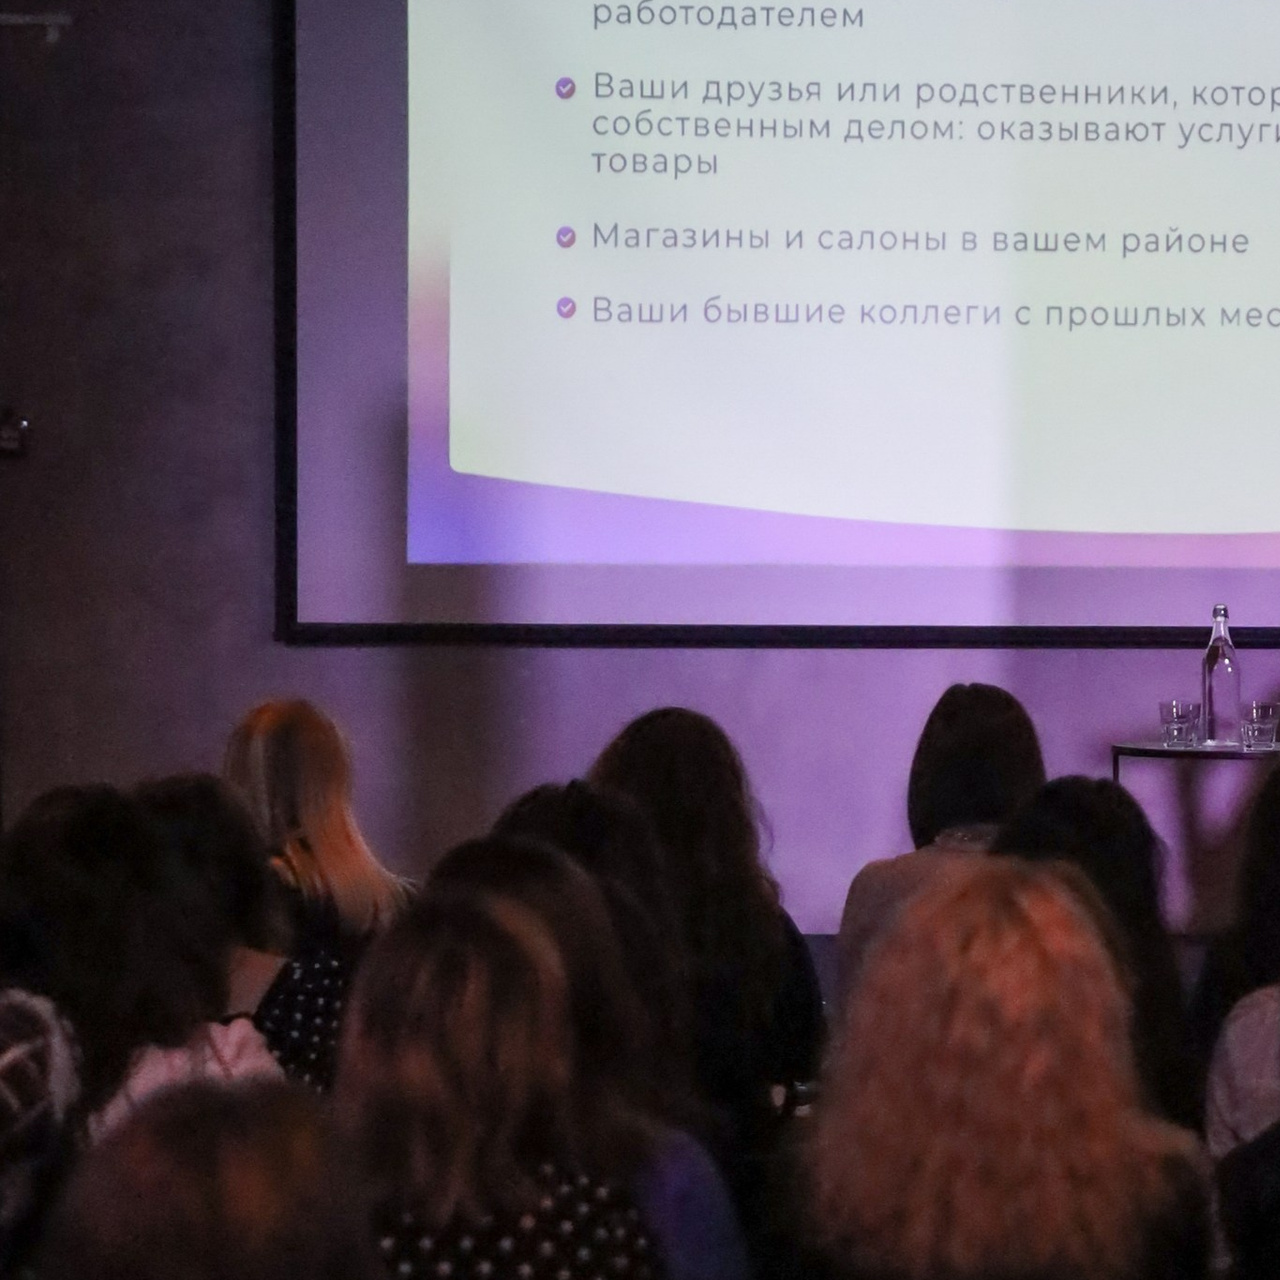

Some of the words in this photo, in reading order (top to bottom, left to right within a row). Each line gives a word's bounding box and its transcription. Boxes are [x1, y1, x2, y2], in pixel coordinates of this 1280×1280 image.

[594, 71, 689, 101] Ваши
[701, 79, 822, 109] друзья
[836, 81, 901, 103] или
[915, 82, 1178, 111] родственники,
[591, 108, 831, 140] собственным
[842, 118, 964, 144] делом:
[976, 119, 1167, 143] оказывают
[590, 151, 718, 181] товары
[592, 221, 770, 250] Магазины
[785, 229, 804, 250] и
[817, 229, 947, 252] салоны
[961, 230, 978, 252] в
[992, 231, 1107, 254] вашем
[1121, 226, 1250, 260] районе
[592, 295, 689, 325] Ваши
[702, 294, 846, 325] бывшие
[859, 303, 1001, 326] коллеги
[1014, 304, 1031, 327] с
[1045, 305, 1206, 333] прошлых
